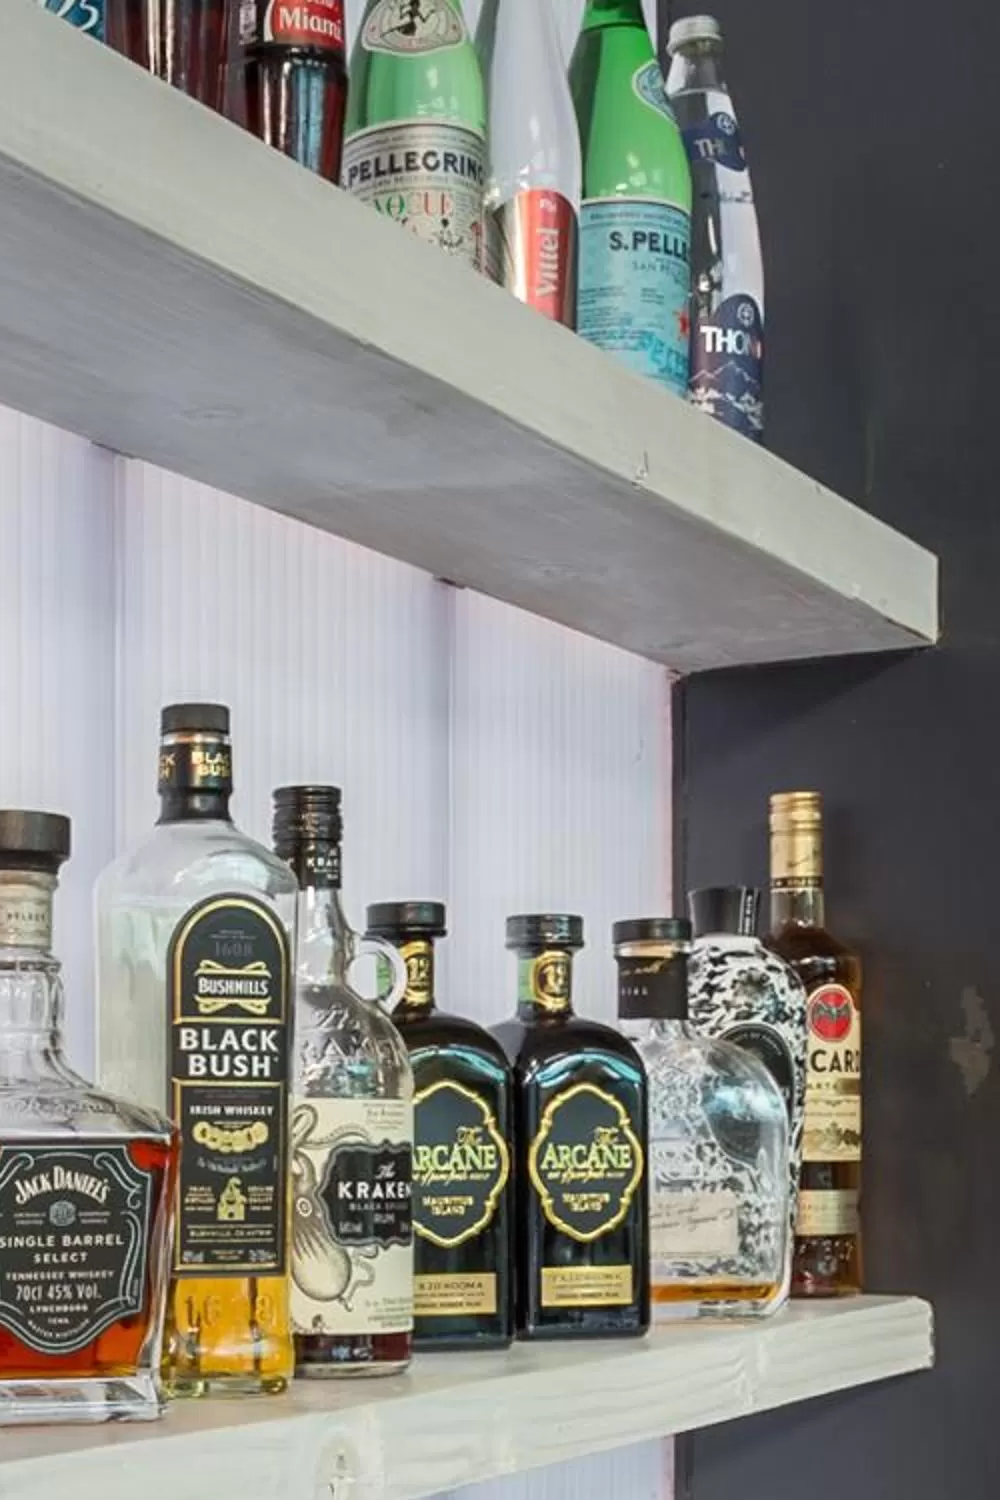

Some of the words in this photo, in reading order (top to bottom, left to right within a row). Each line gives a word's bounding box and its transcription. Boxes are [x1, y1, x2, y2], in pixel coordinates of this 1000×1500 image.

[535, 227, 559, 297] Vittel
[197, 977, 269, 996] BUSHMILLS
[179, 1027, 280, 1052] BLACK
[187, 1053, 272, 1078] BUSH
[224, 1104, 275, 1117] WHISKEY
[540, 1142, 633, 1170] ARCANE
[14, 1171, 53, 1205] JACK
[62, 1233, 125, 1248] BARREL
[32, 1252, 89, 1265] SELECT
